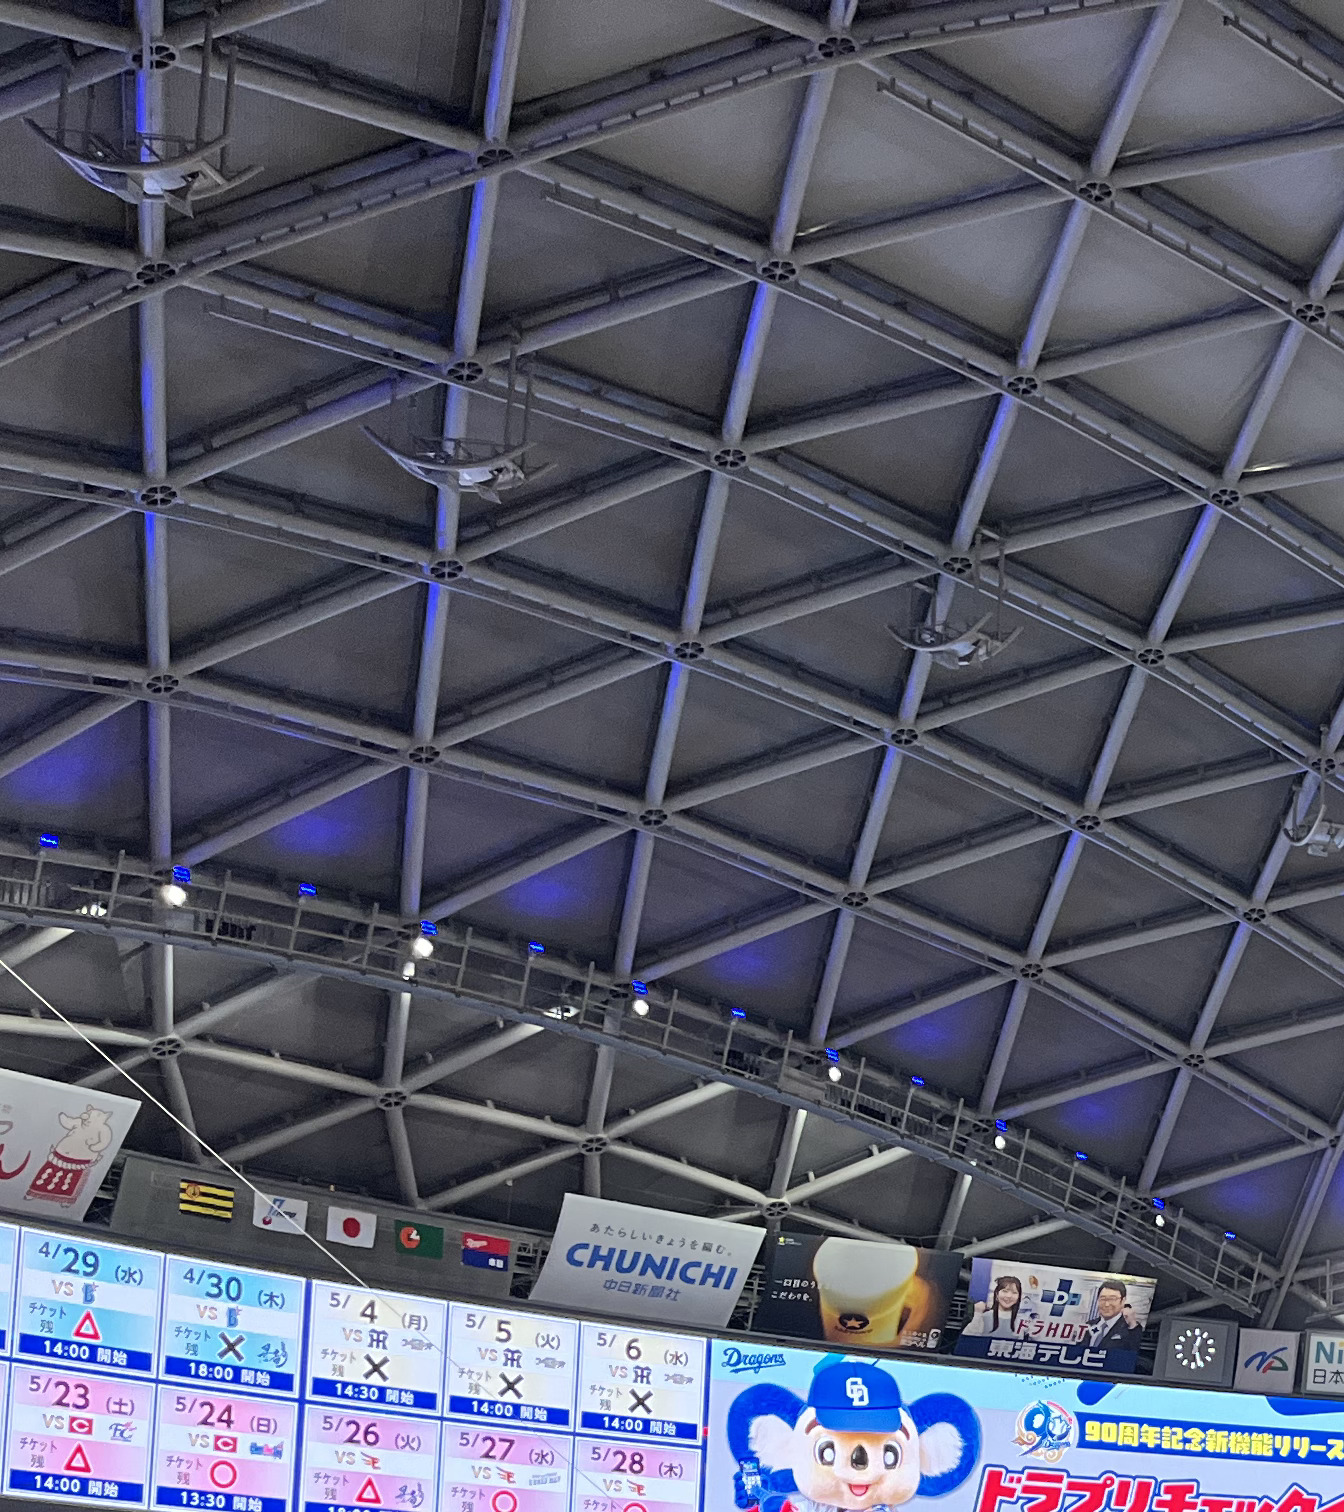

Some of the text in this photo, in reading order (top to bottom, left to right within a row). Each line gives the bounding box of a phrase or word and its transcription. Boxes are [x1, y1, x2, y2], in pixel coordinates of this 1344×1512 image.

[39, 1241, 144, 1286] 4/29 (水)
[566, 1243, 738, 1290] CHUNICHI
[52, 1280, 74, 1296] VS
[183, 1268, 286, 1310] 4/30 (木)
[603, 1279, 681, 1301] 中日新聞社
[29, 1302, 67, 1318] チケット
[196, 1304, 218, 1320] VS
[329, 1292, 429, 1332] 5/ 4 (月)
[174, 1325, 212, 1342] チケット
[342, 1327, 363, 1343] VS
[465, 1313, 561, 1350] 5/ 5 (火)
[43, 1340, 128, 1366] 14:00 開始
[320, 1348, 356, 1363] チケット
[478, 1347, 498, 1362] VS
[596, 1332, 689, 1367] 5/ 6 (水)
[721, 1347, 786, 1374] Dragons
[987, 1340, 1107, 1368] 東海テレビ
[188, 1362, 271, 1387] 18:00 開始
[458, 1367, 492, 1382] チケット
[609, 1364, 628, 1378] VS
[28, 1375, 135, 1416] 5/23 (土)
[335, 1382, 415, 1406] 14:30 開始
[589, 1384, 623, 1398] チケット
[43, 1413, 65, 1430] VS
[174, 1396, 279, 1435] 5/24 (日)
[472, 1400, 548, 1422] 14:00 開始
[321, 1415, 422, 1452] 5/26 (火)
[603, 1416, 676, 1436] 14:00 開始
[19, 1436, 58, 1452] チケット
[459, 1431, 555, 1466] 5/27 (水)
[166, 1455, 203, 1471] チケット
[590, 1446, 684, 1479] 5/28 (木)
[34, 1474, 119, 1498] 14:00 開始
[313, 1472, 349, 1487] チケット
[180, 1491, 263, 1512] 13:30 開始
[450, 1487, 486, 1501] チケット
[583, 1499, 617, 1512] チケット
